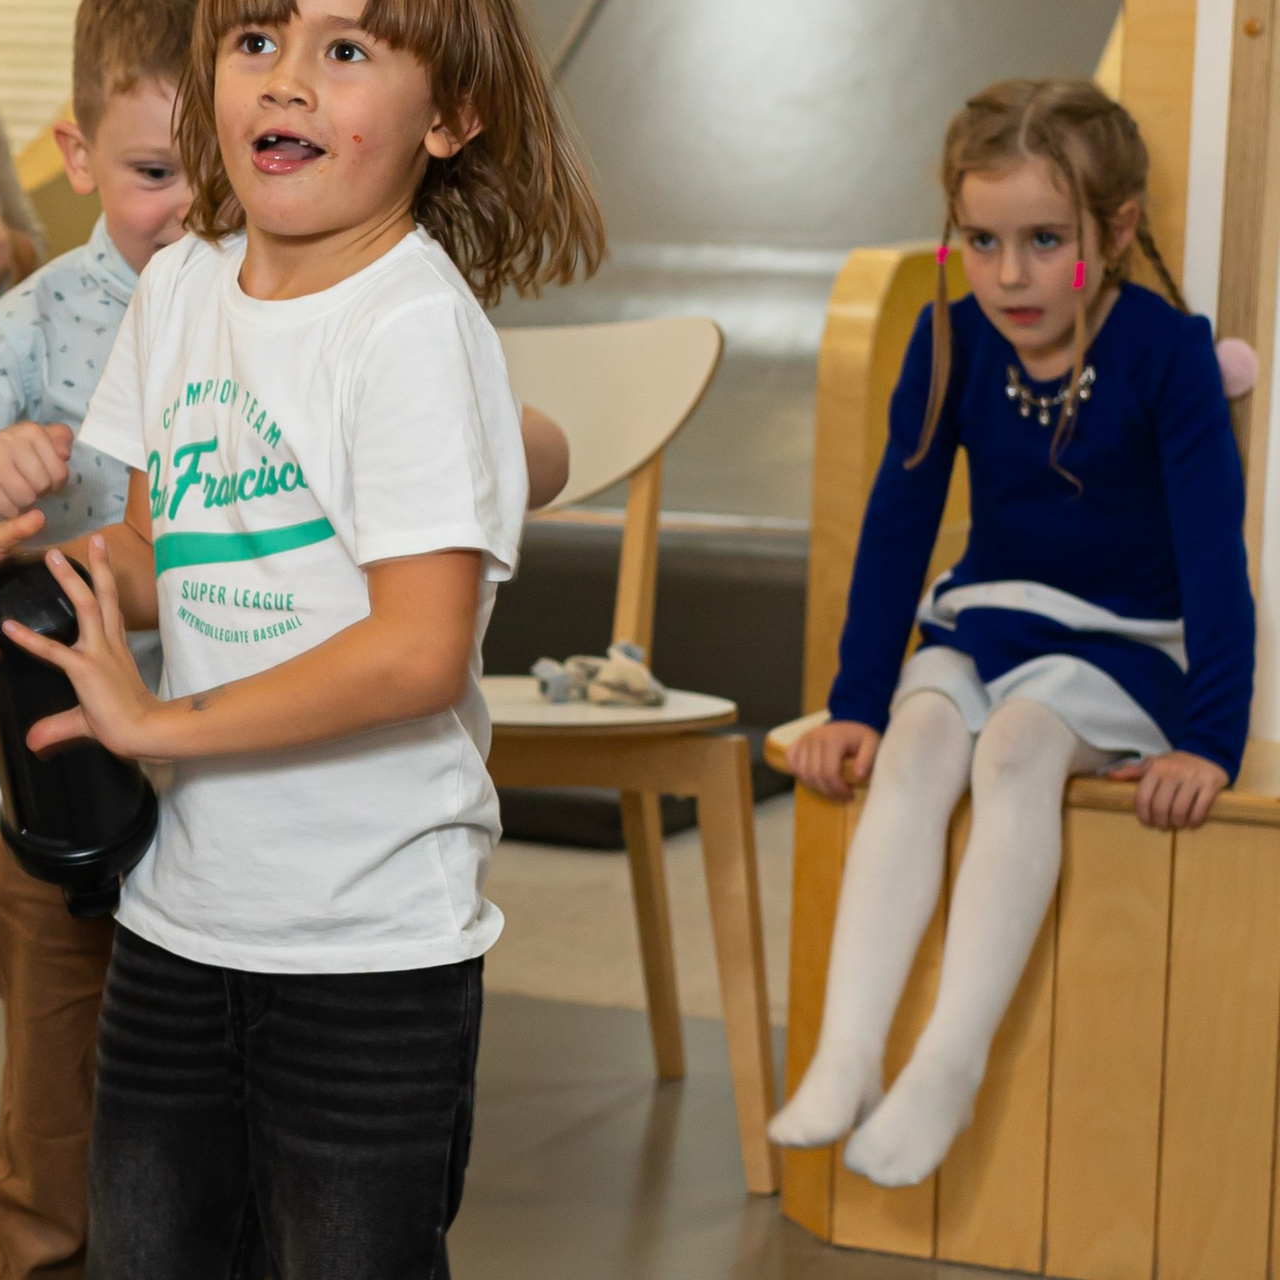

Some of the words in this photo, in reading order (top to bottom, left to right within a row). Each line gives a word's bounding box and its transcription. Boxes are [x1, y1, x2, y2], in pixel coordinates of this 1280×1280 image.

[163, 378, 239, 430] CHMPION
[241, 390, 282, 450] TEAM
[181, 579, 227, 606] SUPER
[233, 587, 294, 611] LEAGUE
[176, 605, 250, 643] INTERCOLLEGIATE
[253, 614, 303, 642] BASEBALL
